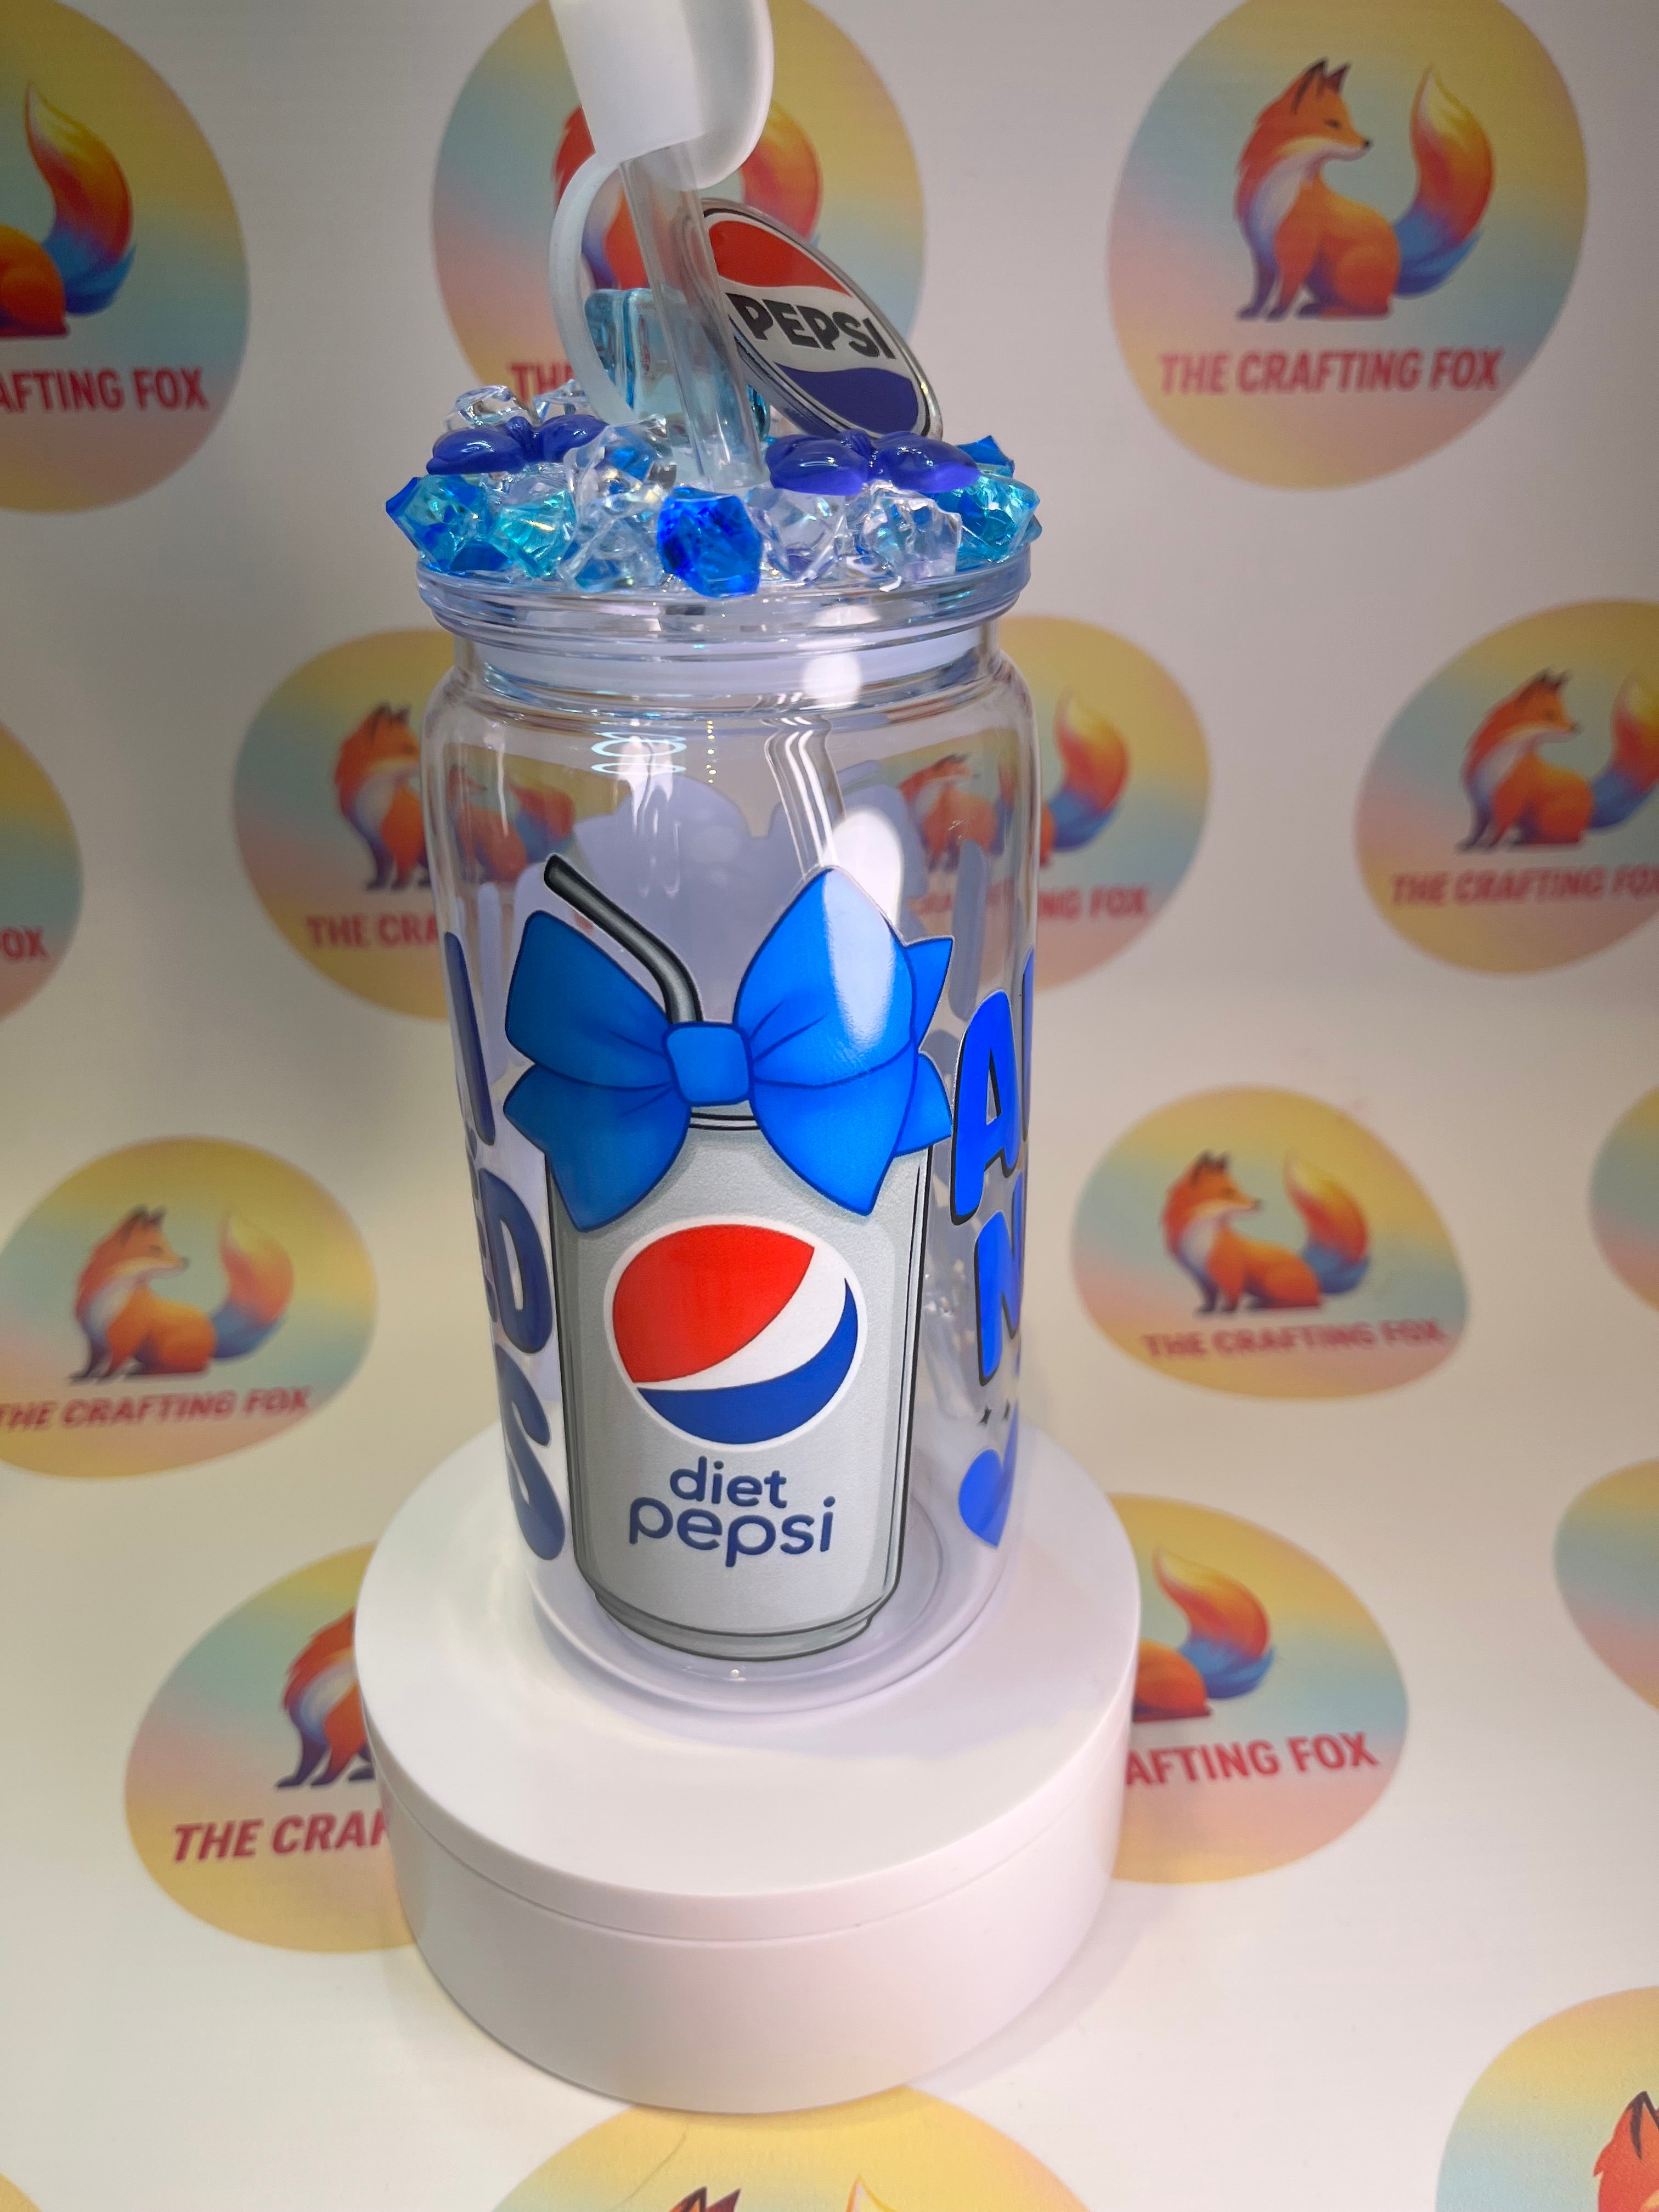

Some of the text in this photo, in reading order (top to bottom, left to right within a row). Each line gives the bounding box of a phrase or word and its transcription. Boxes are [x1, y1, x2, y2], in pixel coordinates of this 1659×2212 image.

[725, 293, 896, 359] PEPSI
[132, 366, 209, 410] FOX
[1159, 348, 1504, 395] THE CRAFTING FOX
[1392, 871, 1449, 907] THE
[0, 925, 50, 960] OX
[63, 1390, 236, 1428] CRAFTING
[244, 1385, 311, 1414] FOX
[669, 1455, 787, 1509] diet
[629, 1496, 836, 1567] pepsi
[1125, 1731, 1380, 1786] AFTING FOX
[174, 1817, 264, 1862] THE
